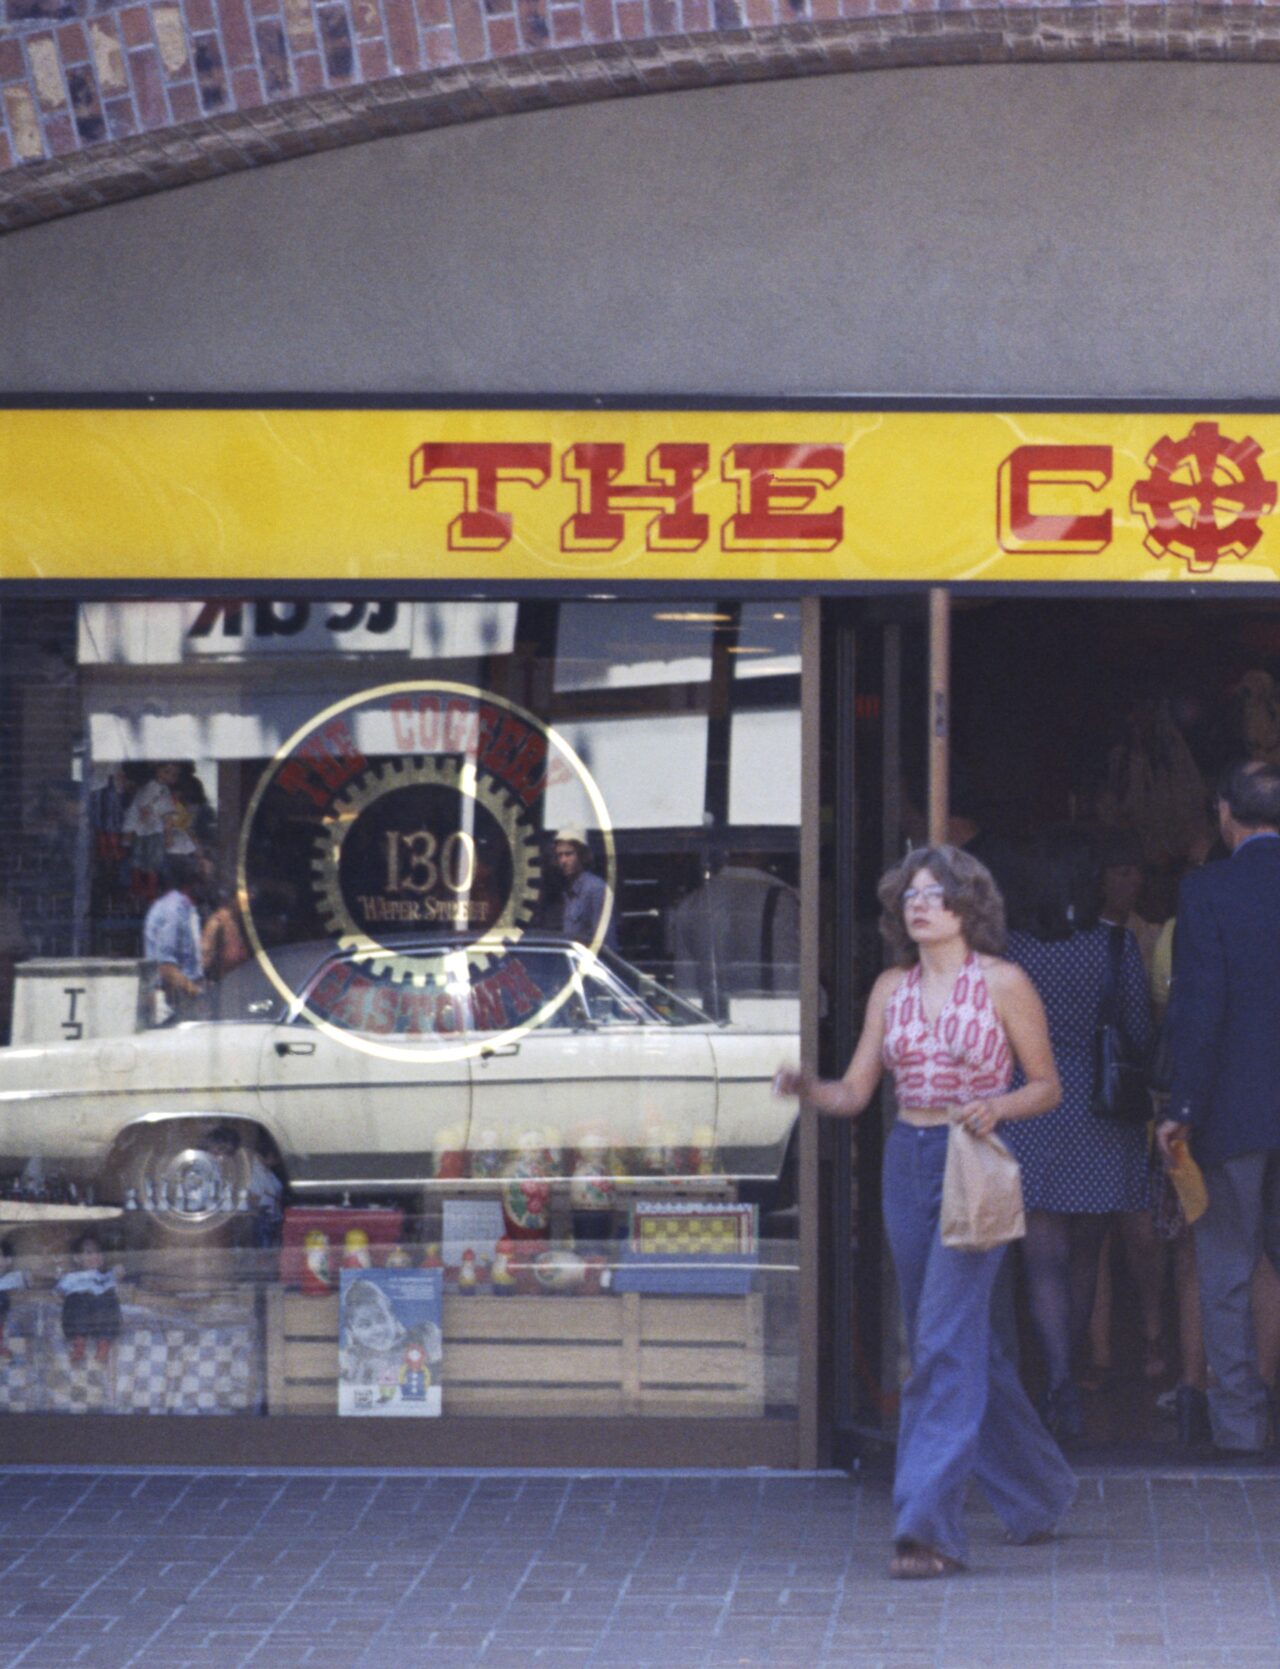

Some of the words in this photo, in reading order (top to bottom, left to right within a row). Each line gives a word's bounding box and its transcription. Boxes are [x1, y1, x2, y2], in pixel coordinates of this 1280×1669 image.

[409, 441, 845, 553] THE
[276, 718, 367, 807] THE
[389, 696, 573, 807] COGGERY
[385, 830, 476, 893] 130
[357, 895, 421, 921] WATER
[424, 895, 490, 921] STREET
[306, 957, 543, 1040] GASTOWN
